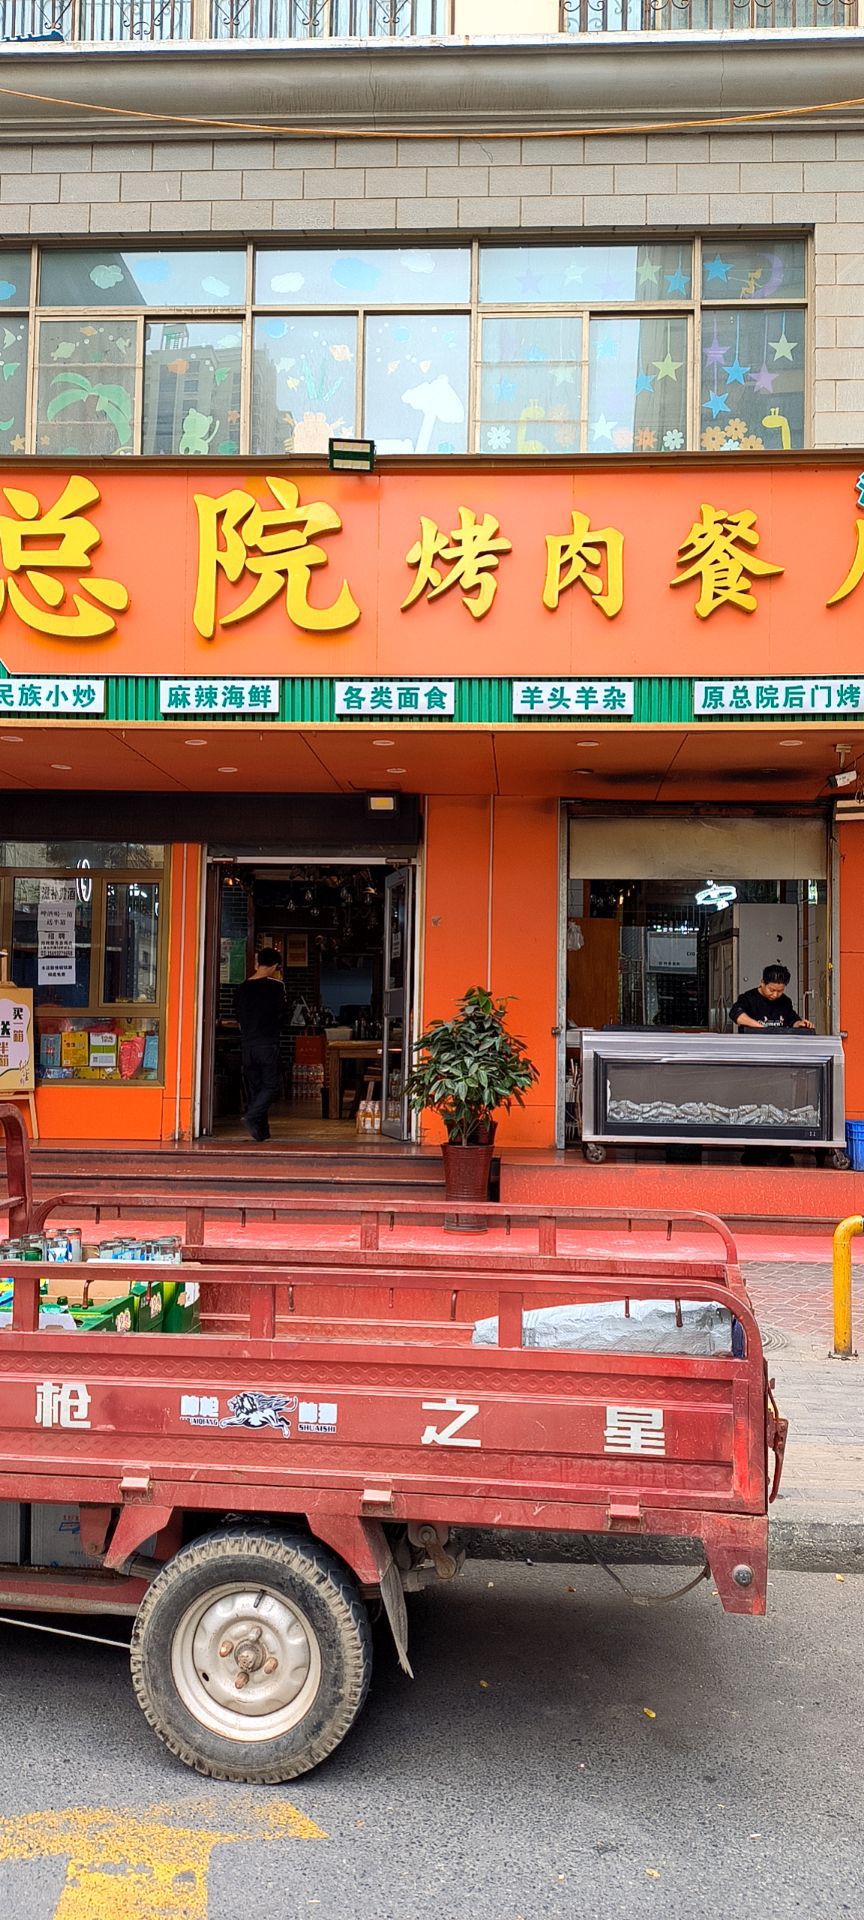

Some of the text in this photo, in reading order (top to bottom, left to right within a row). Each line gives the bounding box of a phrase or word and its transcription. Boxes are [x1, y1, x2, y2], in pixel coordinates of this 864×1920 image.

[0, 475, 362, 639] 总院
[0, 683, 96, 708] 民族小炒
[167, 684, 272, 709] 麻辣海鲜
[343, 685, 447, 710] 各类面食
[520, 686, 626, 710] 羊头羊杂
[701, 684, 861, 710] 原总院后门烤
[13, 1007, 24, 1042] 买一箱
[35, 1381, 665, 1456] 枪 之 星
